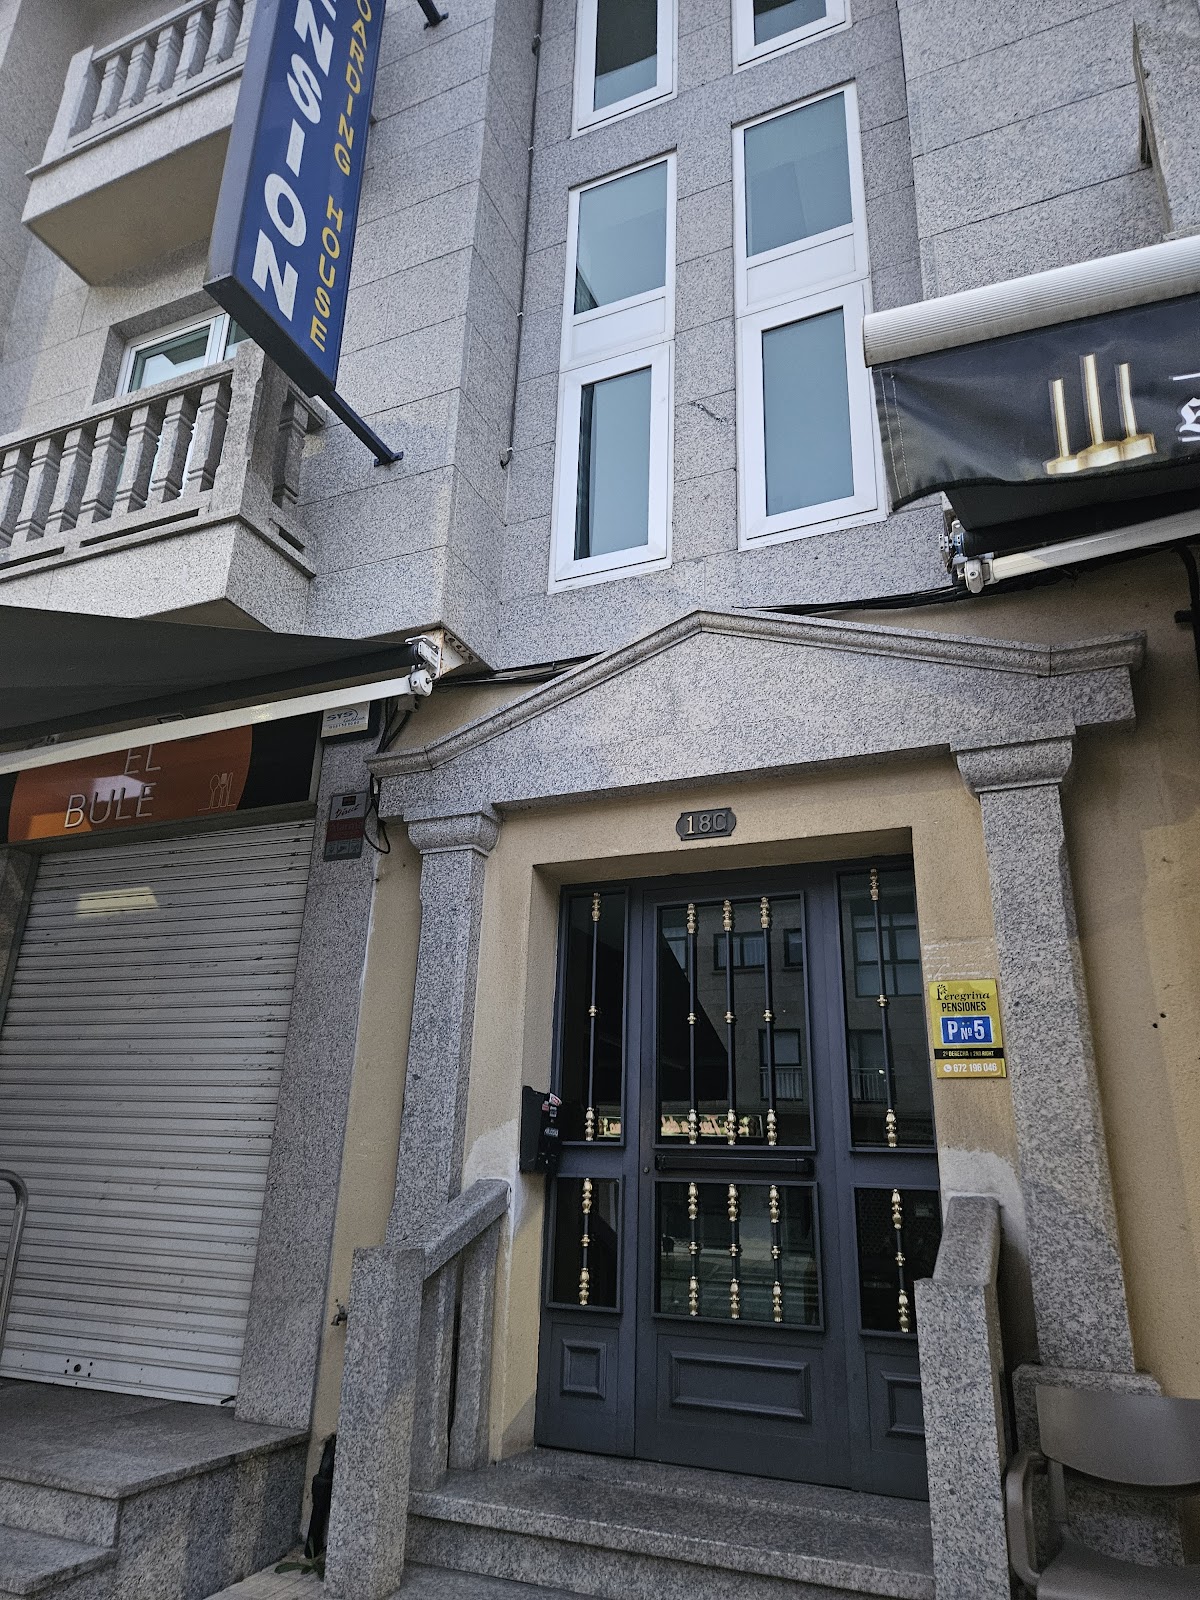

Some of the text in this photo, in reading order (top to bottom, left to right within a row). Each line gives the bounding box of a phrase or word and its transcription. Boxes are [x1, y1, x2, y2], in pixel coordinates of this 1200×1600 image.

[309, 195, 344, 353] HOUSE
[326, 710, 354, 721] SYS
[124, 744, 162, 776] EL
[64, 782, 157, 829] BULE
[687, 813, 727, 834] 18C
[936, 984, 990, 1002] Peregrina
[941, 1001, 988, 1012] PENSIONES
[947, 1020, 958, 1040] P
[974, 1019, 985, 1040] 5
[953, 1063, 967, 1073] 672
